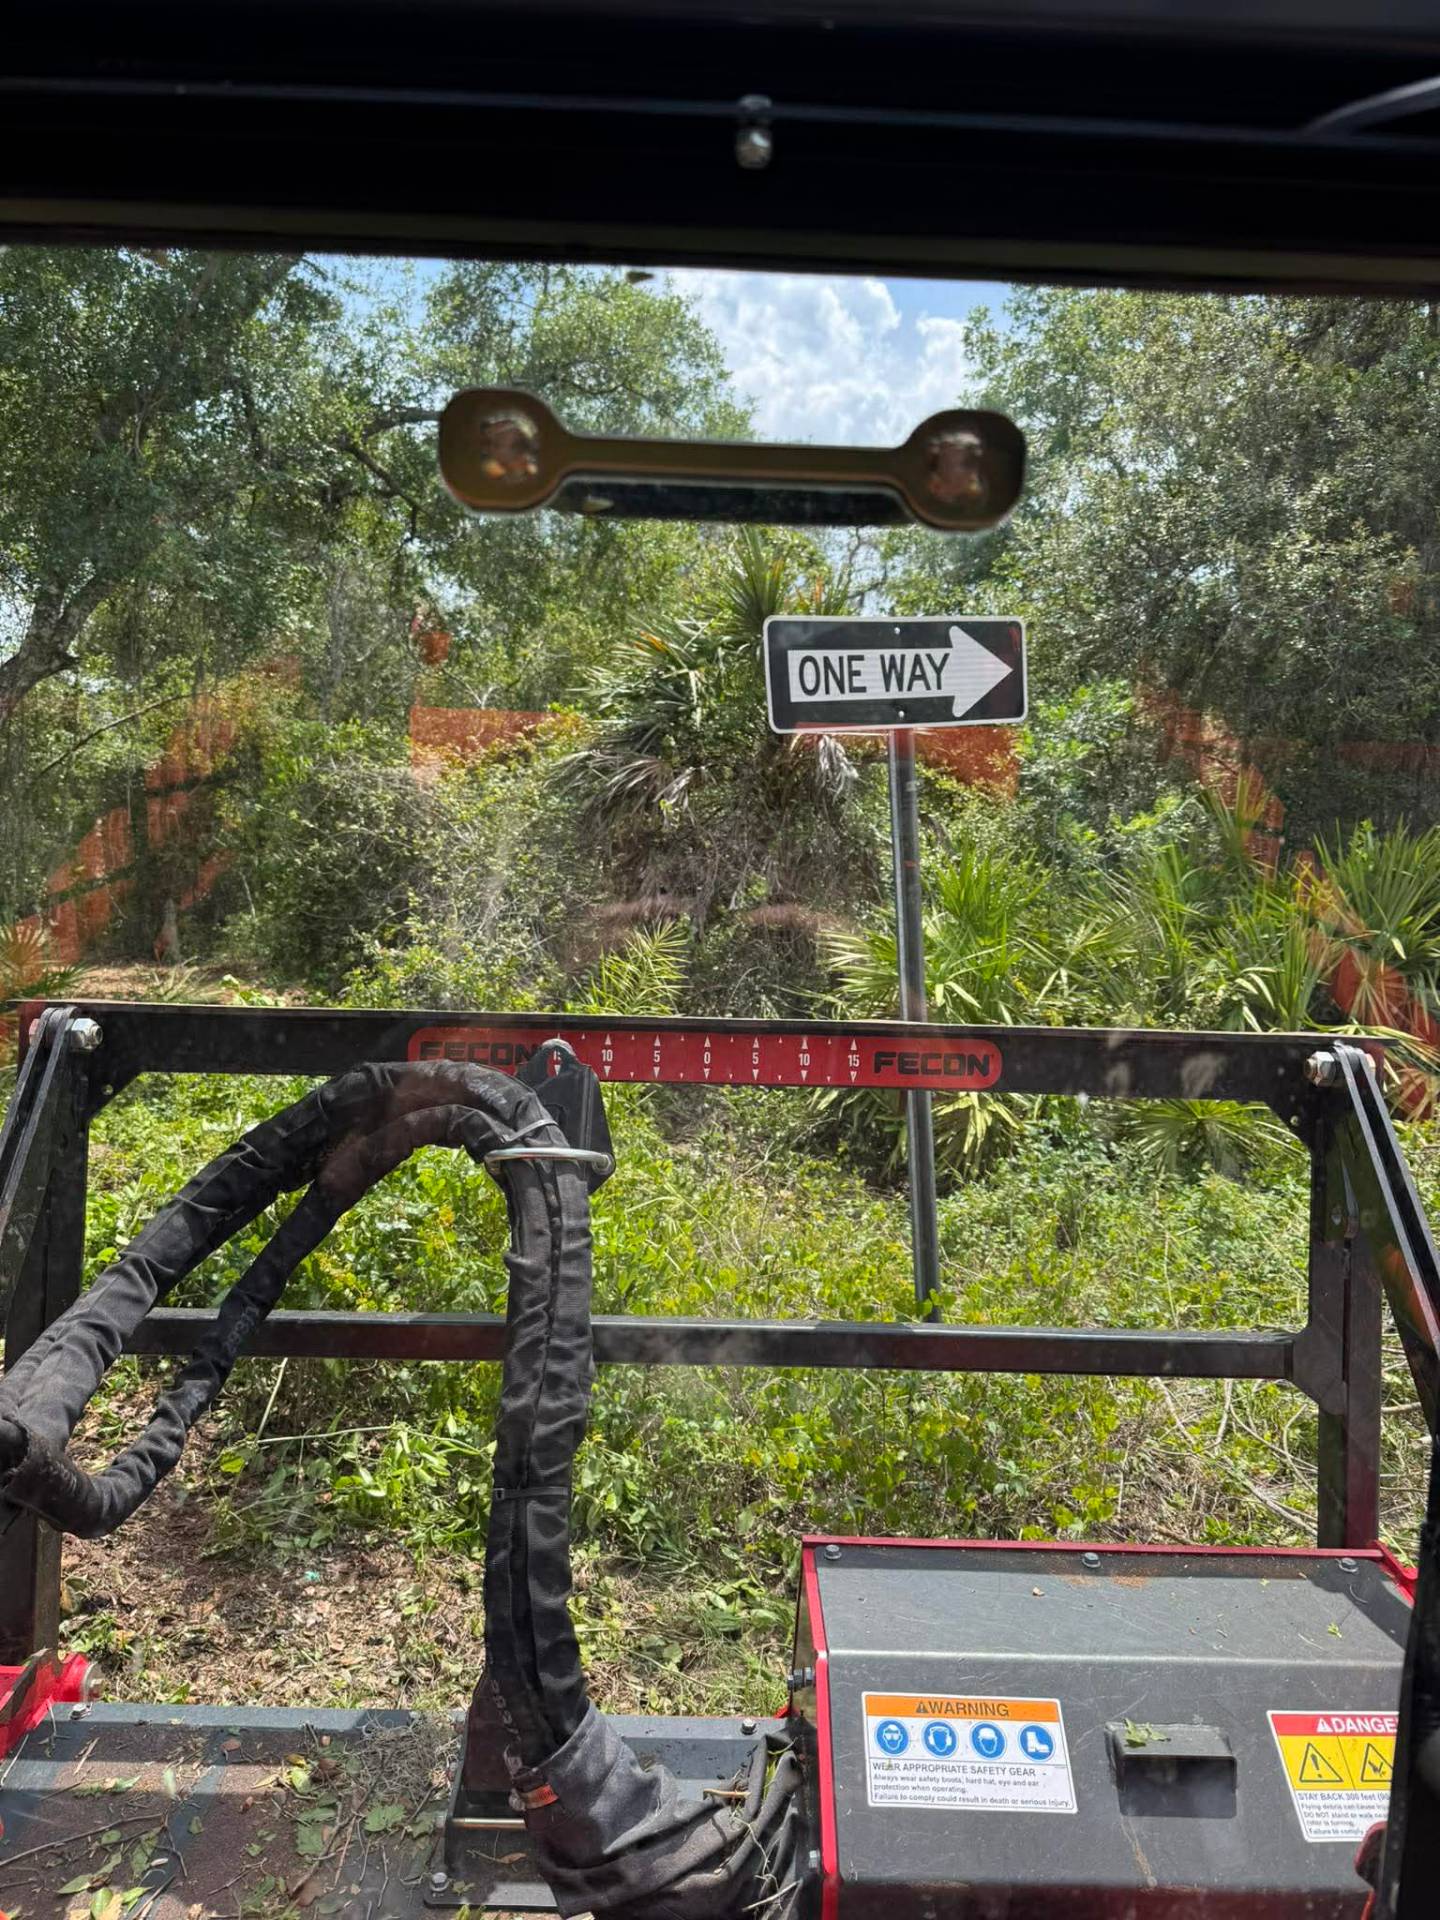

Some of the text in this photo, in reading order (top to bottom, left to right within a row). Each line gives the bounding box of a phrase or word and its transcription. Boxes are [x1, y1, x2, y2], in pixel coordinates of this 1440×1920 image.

[799, 652, 950, 696] ONE WAY
[602, 1050, 613, 1062] 10
[653, 1050, 661, 1062] 5
[703, 1052, 711, 1064] 0
[752, 1052, 759, 1065] 5
[799, 1054, 810, 1066] 10
[848, 1054, 860, 1067] 15
[873, 1052, 990, 1077] FECON
[927, 1701, 1009, 1717] WARNING
[1332, 1717, 1399, 1733] DANGE
[873, 1762, 1036, 1777] WEAR APPROPRIATE SAFETY GEAR
[874, 1774, 898, 1782] Always
[919, 1775, 940, 1784] safety
[874, 1783, 910, 1791] protection
[900, 1793, 908, 1801] to
[909, 1794, 935, 1803] comply
[989, 1796, 1009, 1804] death
[1298, 1792, 1318, 1800] STAY
[1320, 1792, 1344, 1800] BACK
